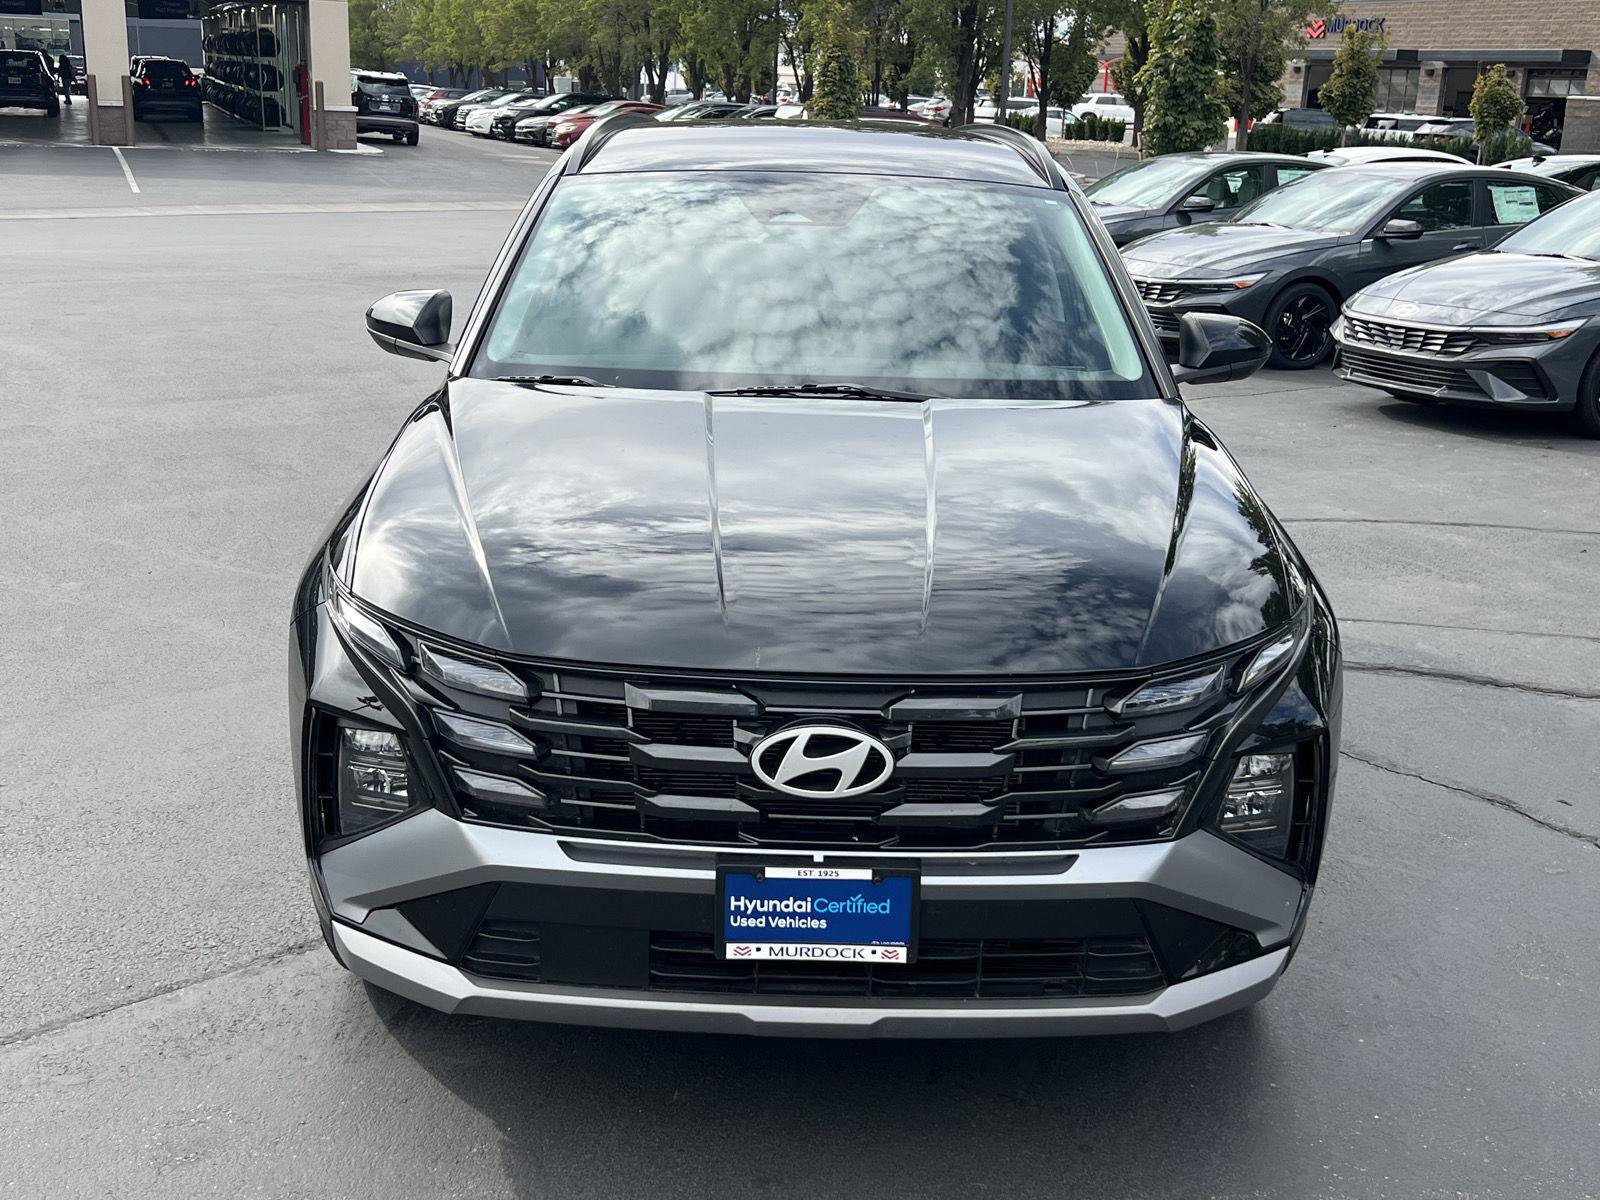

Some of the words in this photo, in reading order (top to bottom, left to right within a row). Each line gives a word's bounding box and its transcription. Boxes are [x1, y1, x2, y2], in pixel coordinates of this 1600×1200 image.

[797, 869, 815, 877] EST.
[817, 869, 840, 877] 1925
[730, 896, 812, 914] Hyundai
[814, 894, 890, 914] Certified
[730, 916, 766, 927] Used
[768, 916, 827, 928] Vehicles
[769, 947, 865, 959] MURDOCK
